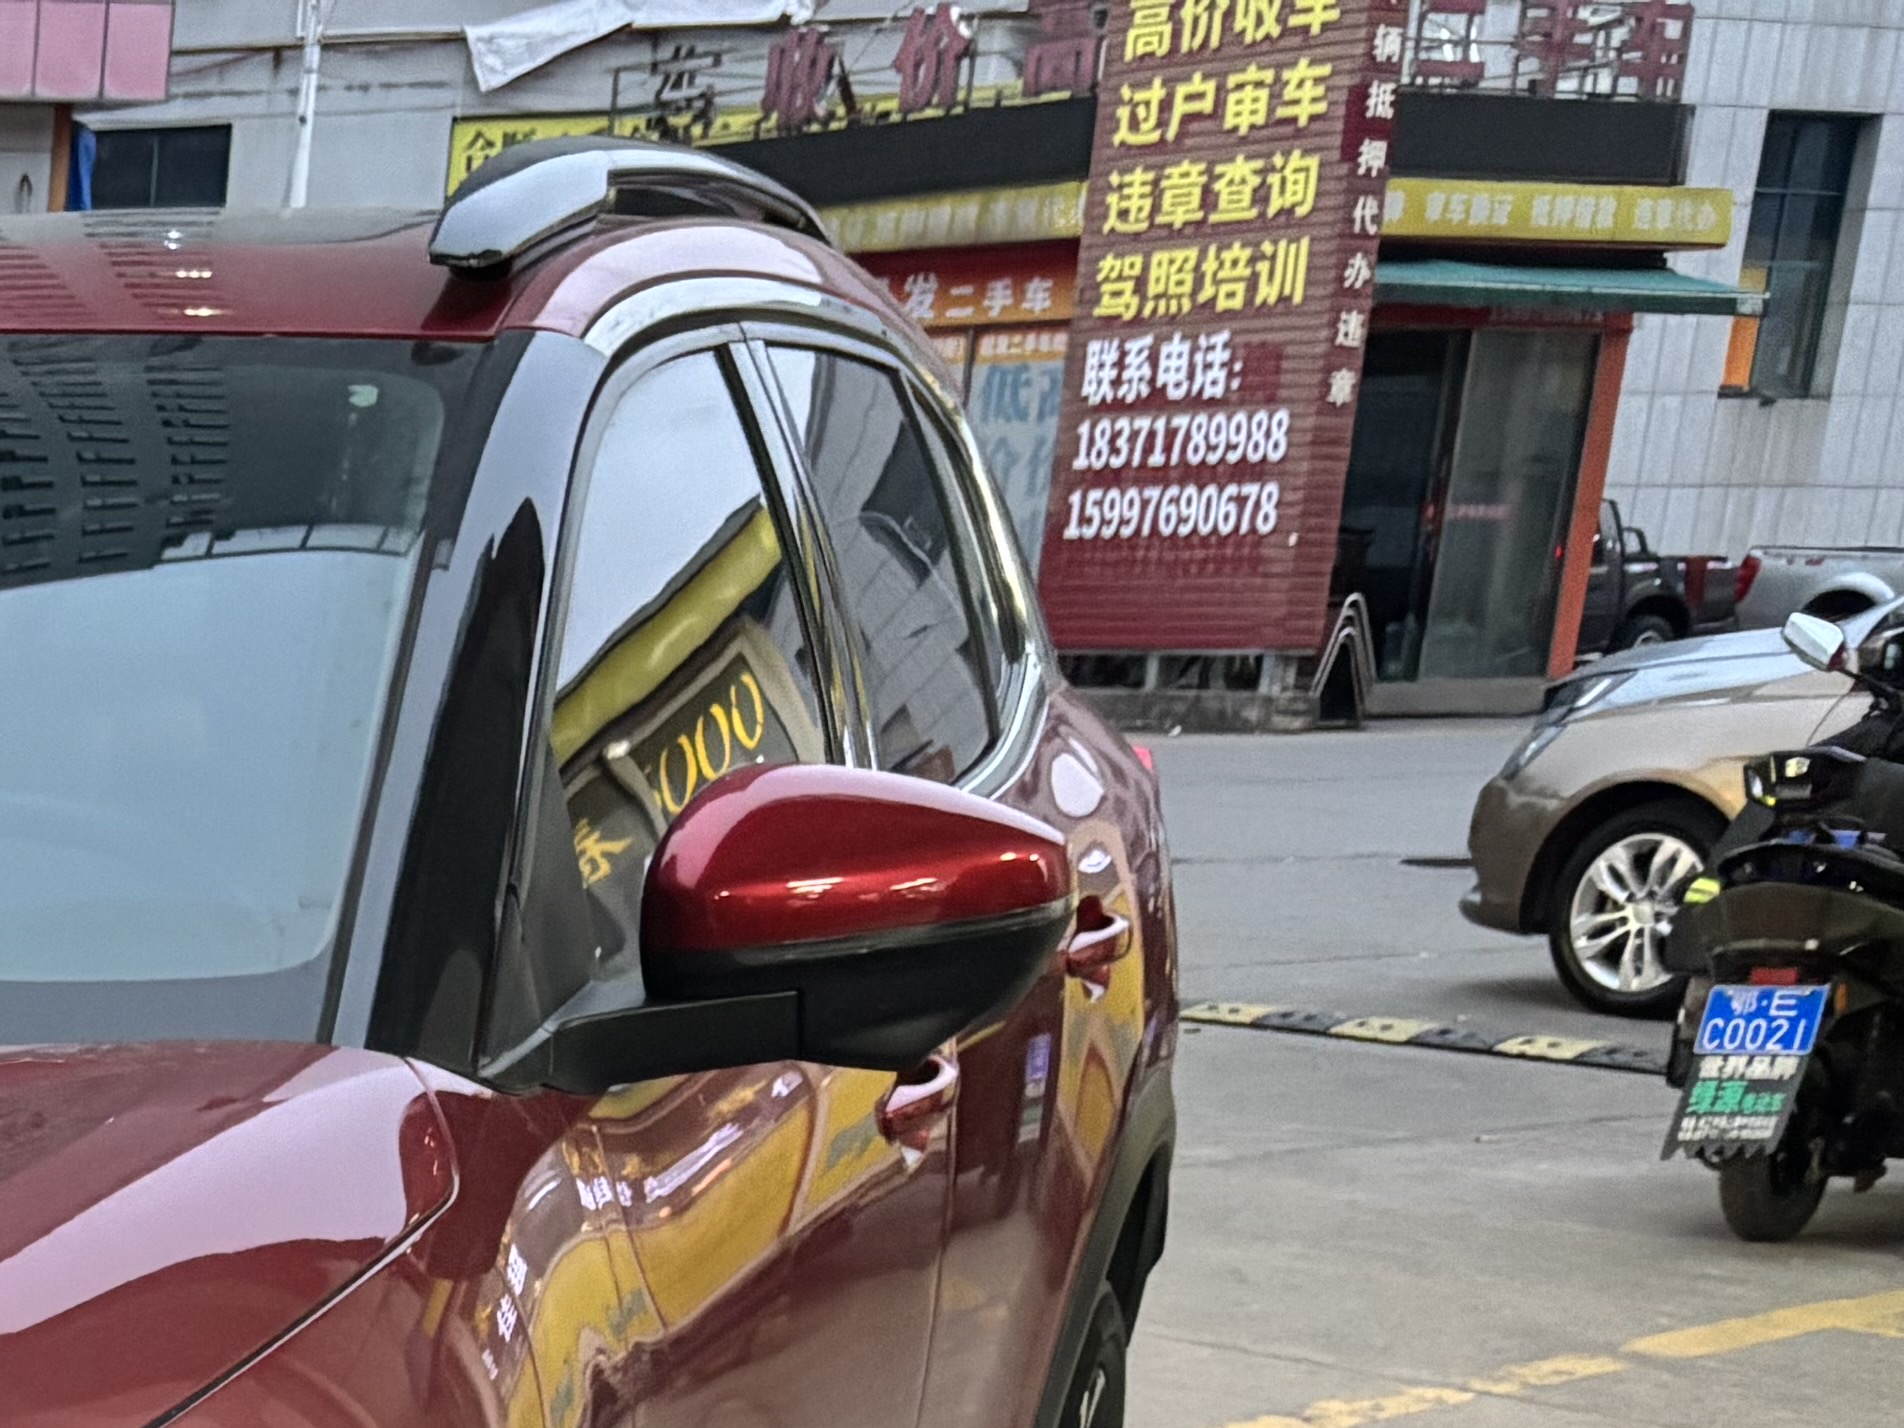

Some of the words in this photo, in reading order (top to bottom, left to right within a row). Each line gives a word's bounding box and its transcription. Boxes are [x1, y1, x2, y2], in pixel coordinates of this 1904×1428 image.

[1111, 57, 1333, 148] 过户审车
[1103, 149, 1321, 235] 违章查询
[1093, 235, 1311, 321] 驾照培训
[1081, 328, 1244, 407] 联系电话:
[1072, 408, 1290, 471] 18371789988
[1062, 480, 1280, 540] 15997690678
[1702, 1017, 1807, 1051] C0021
